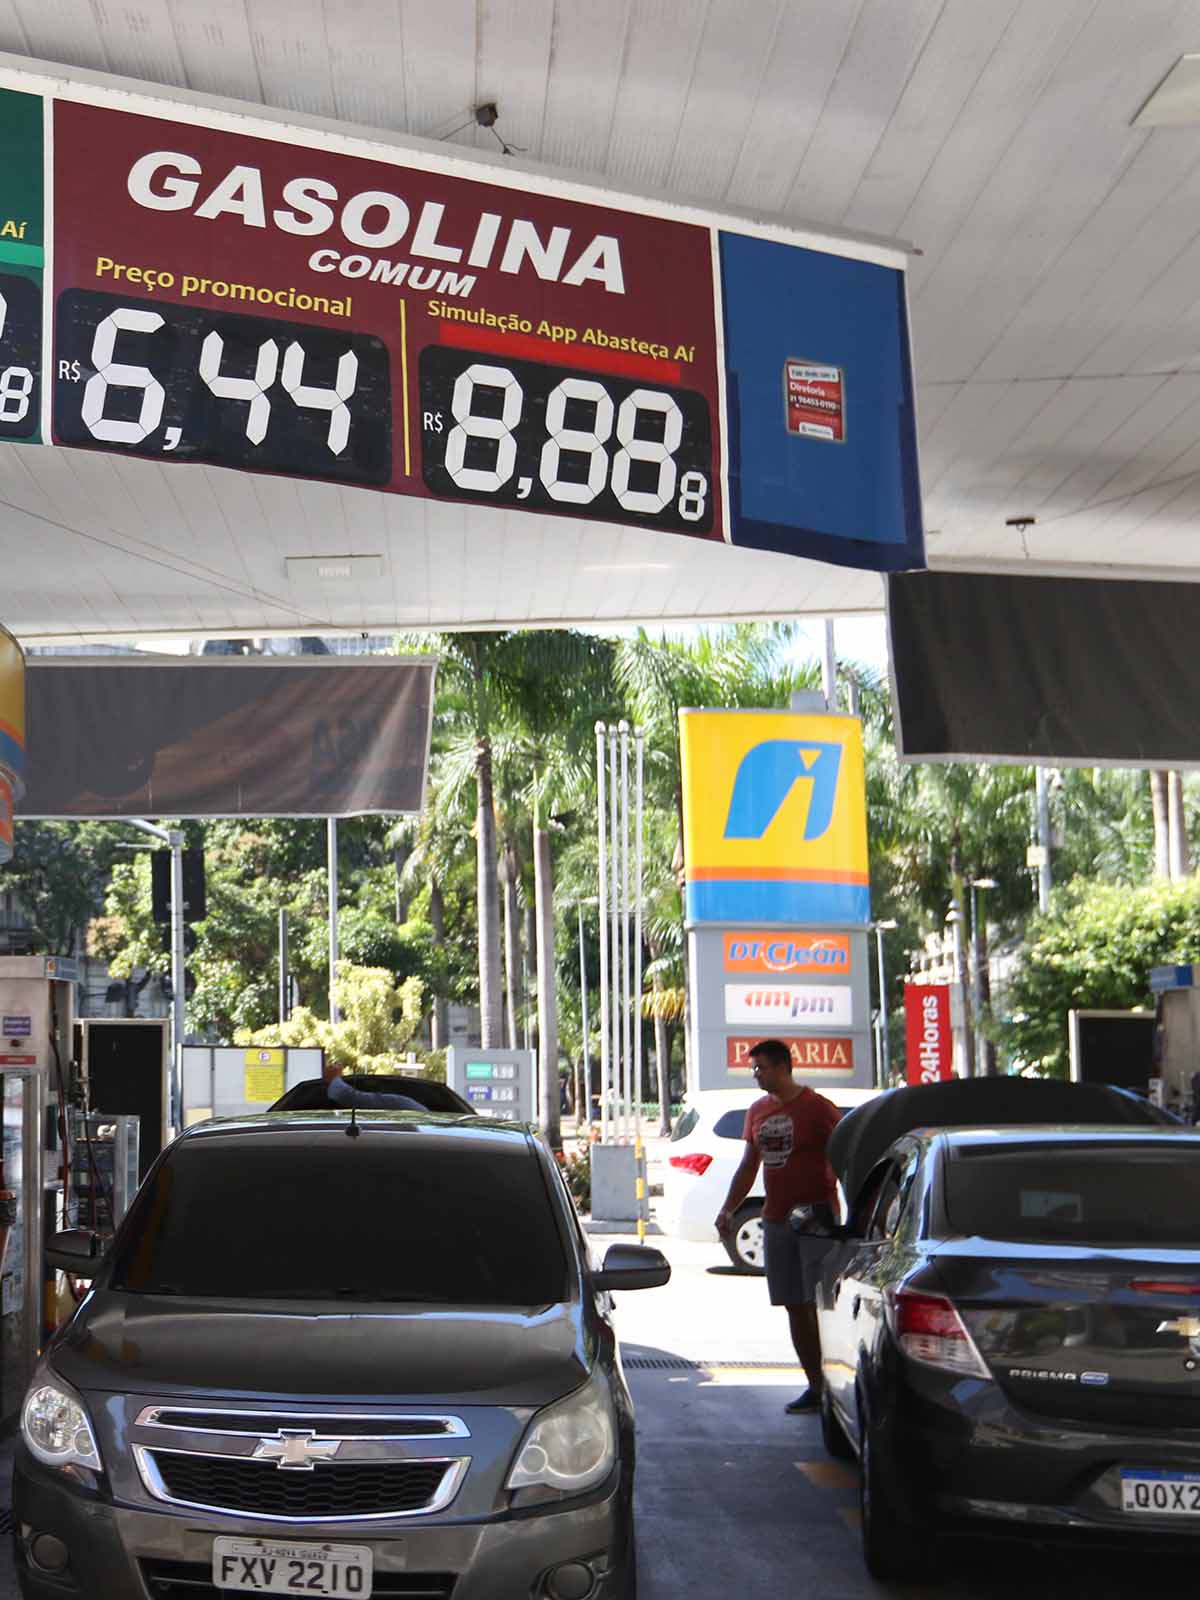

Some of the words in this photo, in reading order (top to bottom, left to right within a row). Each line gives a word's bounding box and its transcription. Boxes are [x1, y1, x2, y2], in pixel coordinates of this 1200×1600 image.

[0, 220, 28, 240] Aí
[127, 151, 625, 294] GASOLINA
[95, 256, 174, 291] Preço
[181, 275, 352, 317] promocional
[308, 248, 477, 298] COMUM
[428, 300, 532, 334] Simulação
[537, 319, 578, 344] App
[582, 327, 669, 360] Abasteça
[673, 345, 695, 362] Aí
[58, 359, 81, 383] R$
[81, 307, 358, 456] 6,44
[423, 411, 443, 435] R$
[767, 942, 846, 966] Clean
[734, 1041, 848, 1064] PARIA
[919, 995, 941, 1083] 24Horas
[222, 1555, 277, 1585] FXV
[288, 1560, 363, 1592] 2210
